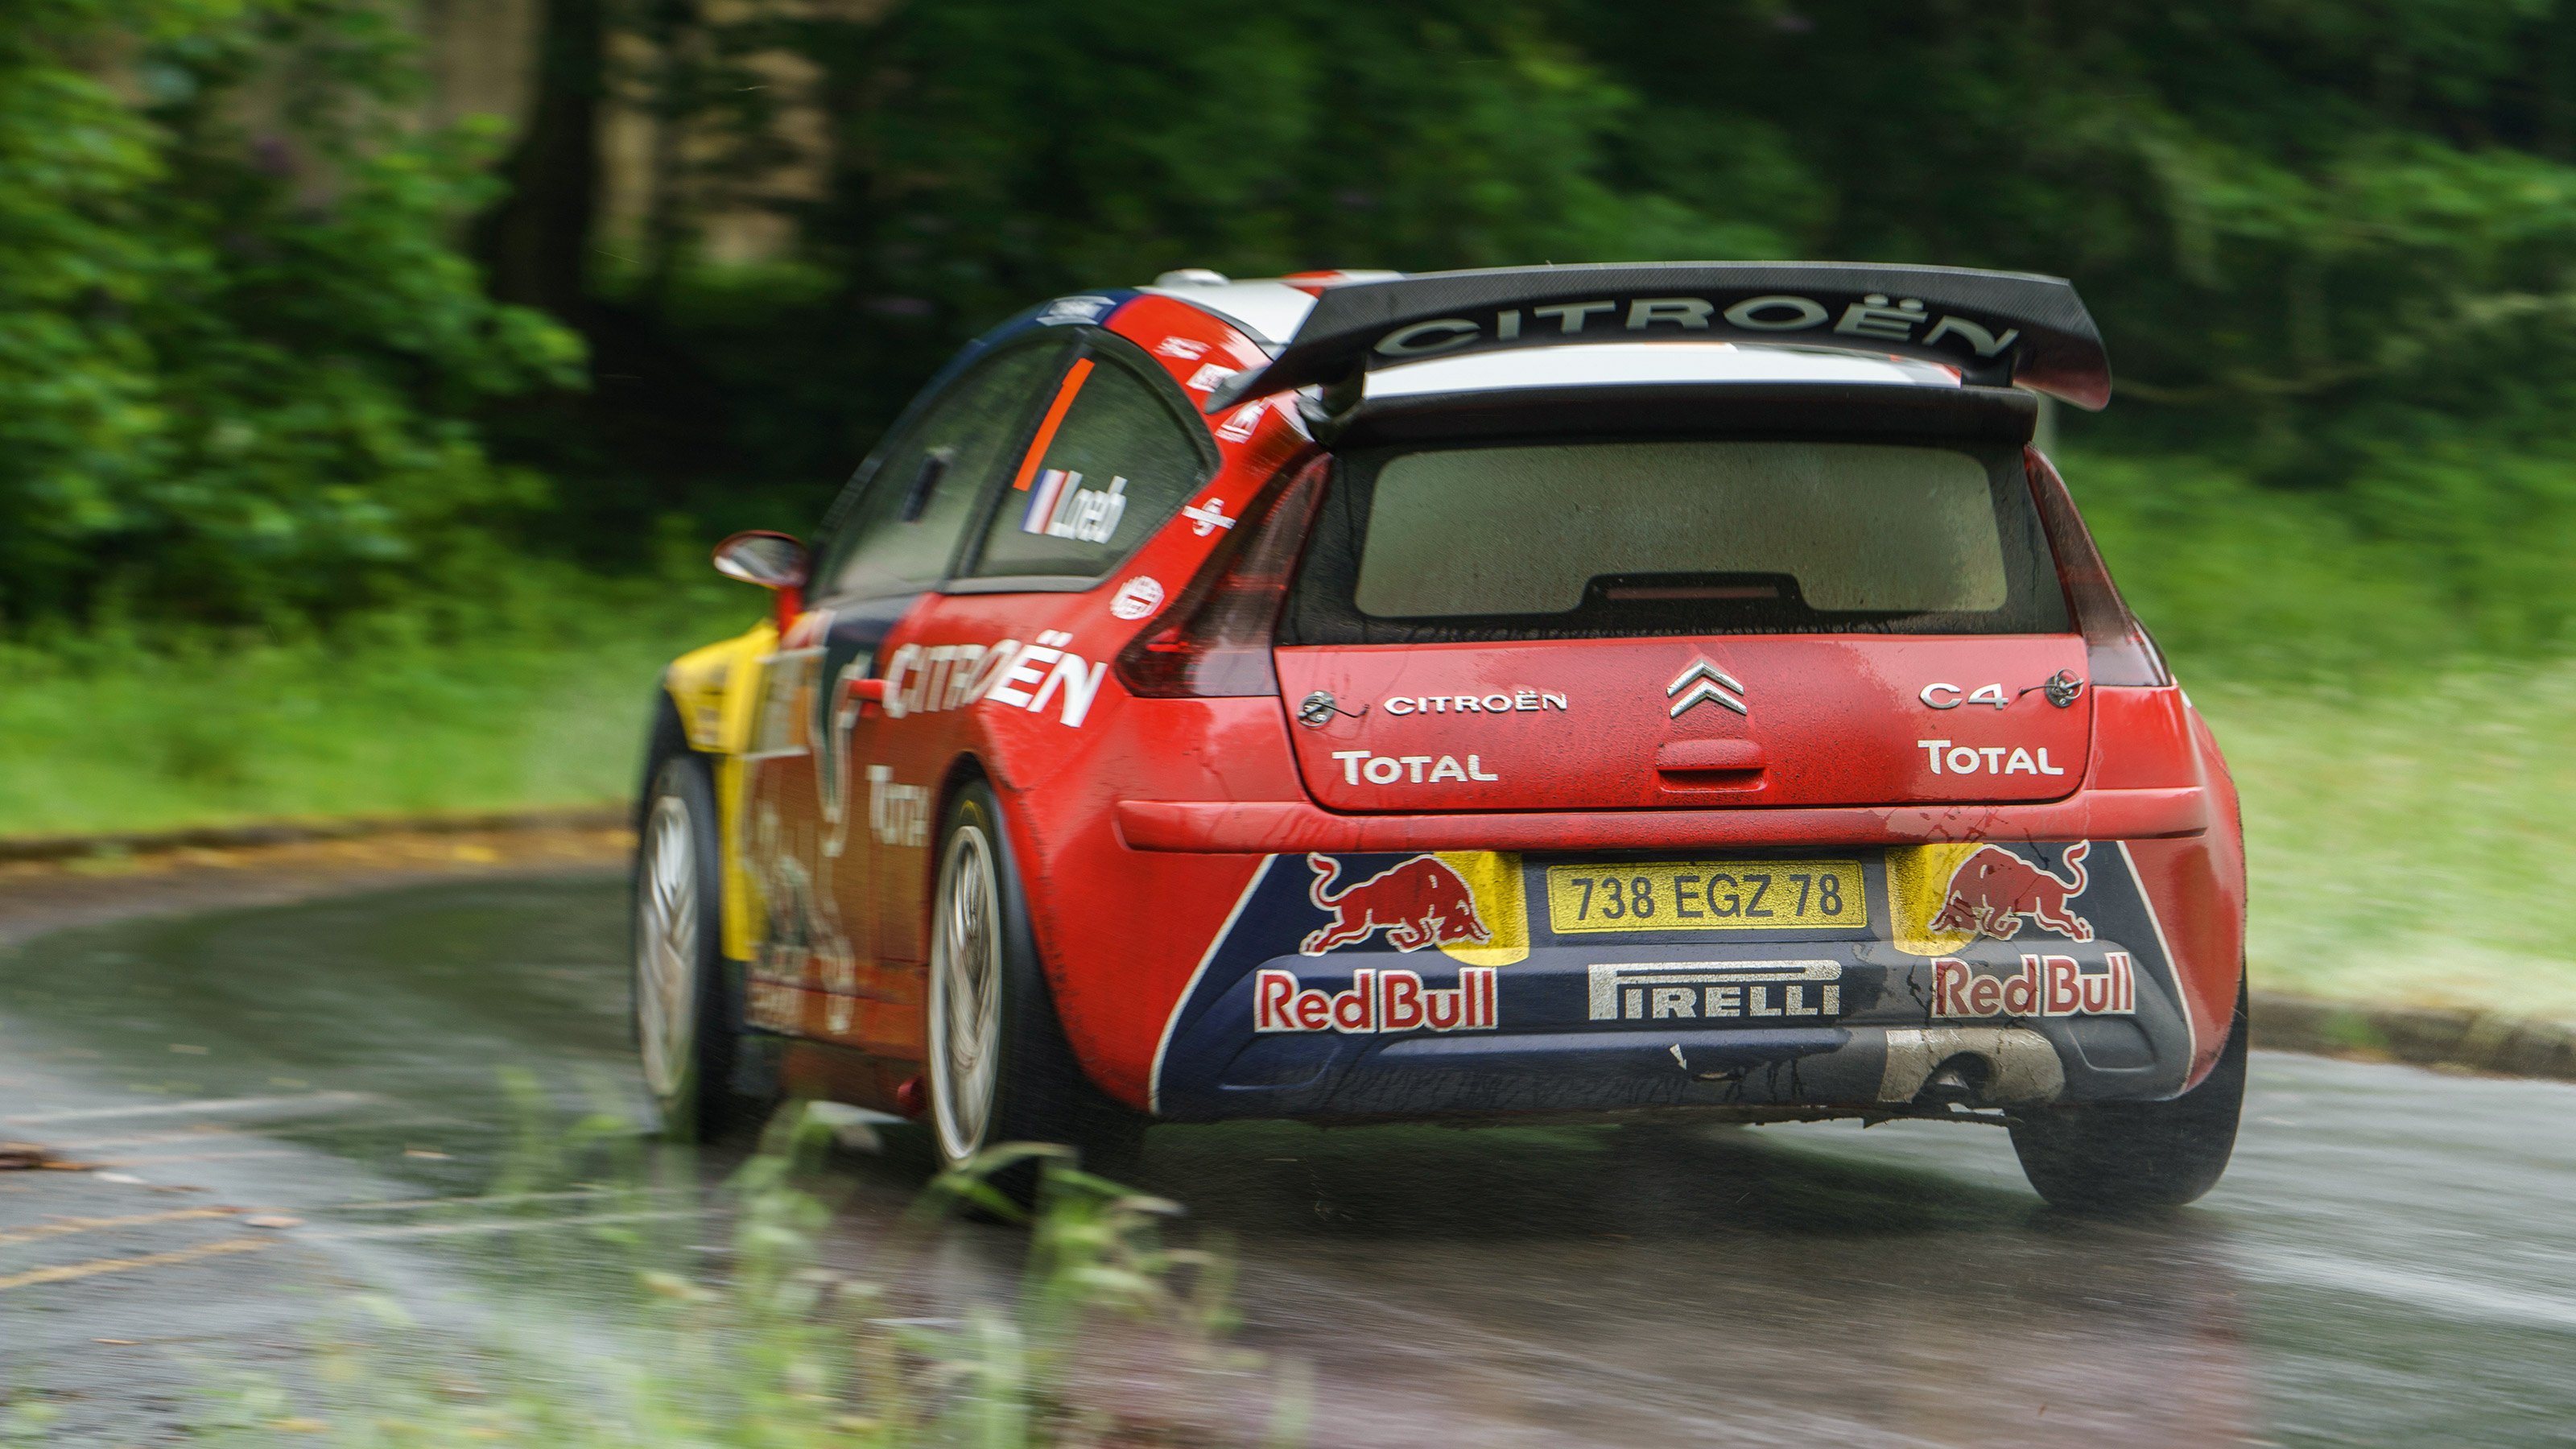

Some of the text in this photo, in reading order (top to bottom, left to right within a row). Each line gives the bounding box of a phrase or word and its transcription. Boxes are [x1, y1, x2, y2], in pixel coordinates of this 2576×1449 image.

[1373, 294, 2019, 358] CITROËN
[882, 630, 1108, 728] CITROËN
[1918, 683, 2009, 710] C4
[1384, 691, 1567, 716] CITROËN
[1332, 751, 1498, 786] TOTAL
[1918, 739, 2064, 775] TOTAL
[1571, 872, 1843, 920] 738 EGZ 78
[1588, 960, 1843, 1021] PIRELLI
